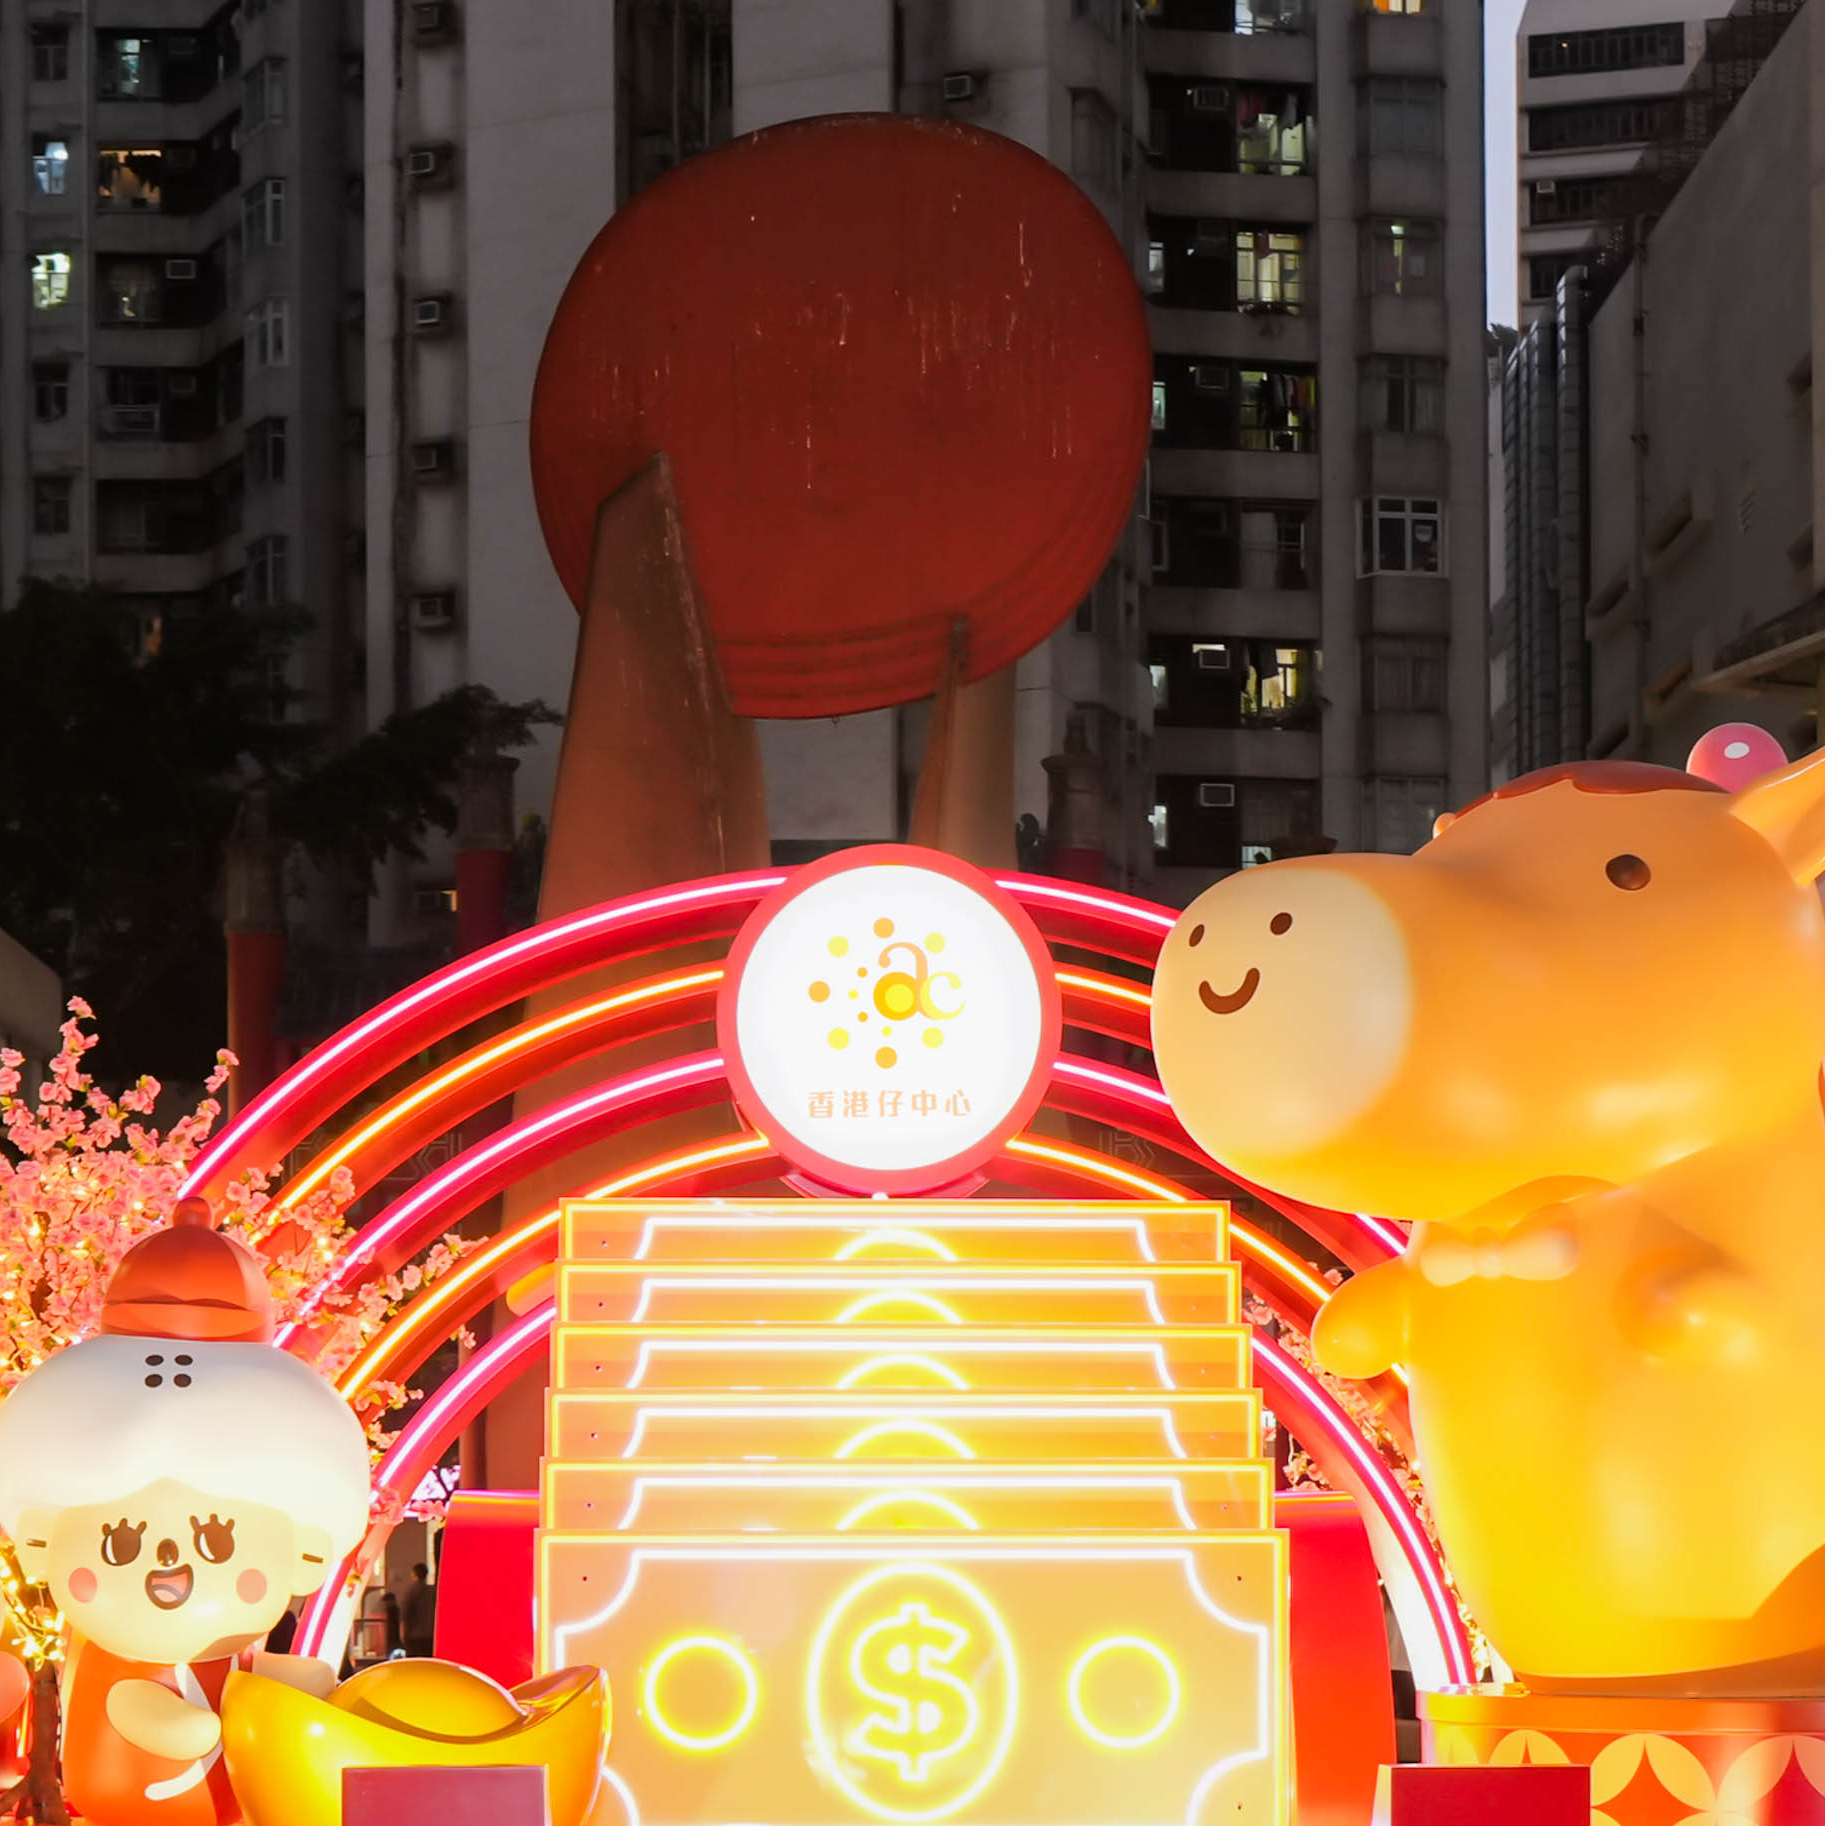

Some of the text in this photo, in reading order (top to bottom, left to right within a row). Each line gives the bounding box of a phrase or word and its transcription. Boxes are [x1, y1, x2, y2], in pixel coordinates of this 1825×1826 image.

[808, 1089, 971, 1119] 香港仔中心
